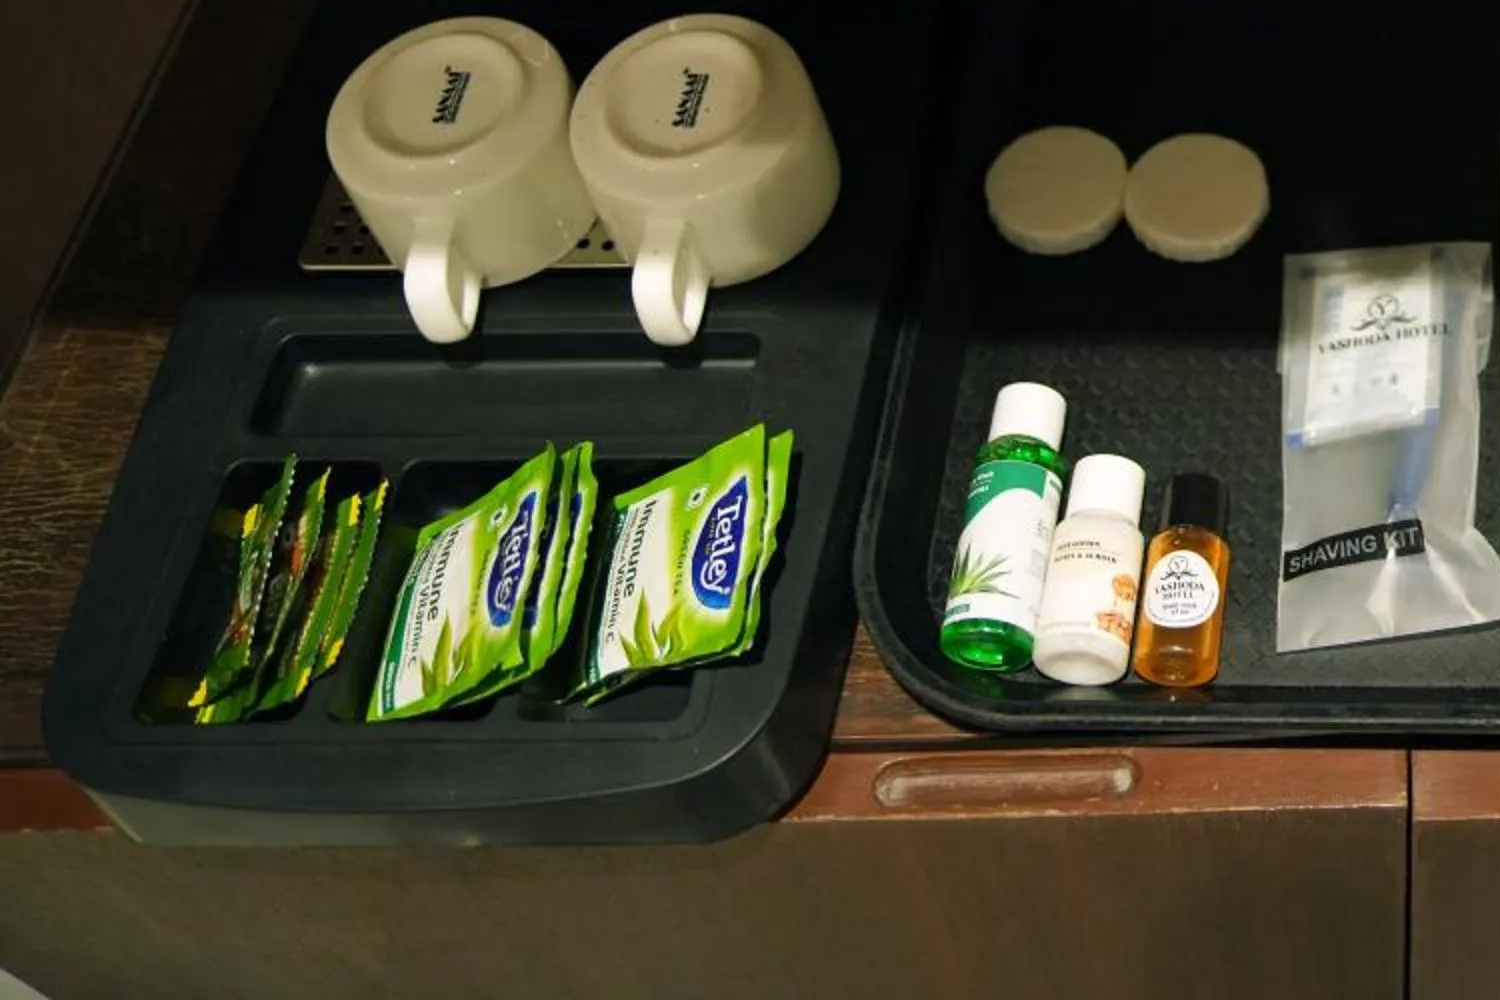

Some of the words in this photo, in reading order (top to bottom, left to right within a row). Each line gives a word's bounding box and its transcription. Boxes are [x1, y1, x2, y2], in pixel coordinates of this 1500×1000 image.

[1396, 322, 1450, 338] HOTEL
[624, 500, 657, 597] Immune
[700, 495, 743, 594] Tetley
[1290, 534, 1378, 573] SHAVING
[1384, 527, 1418, 551] KIT
